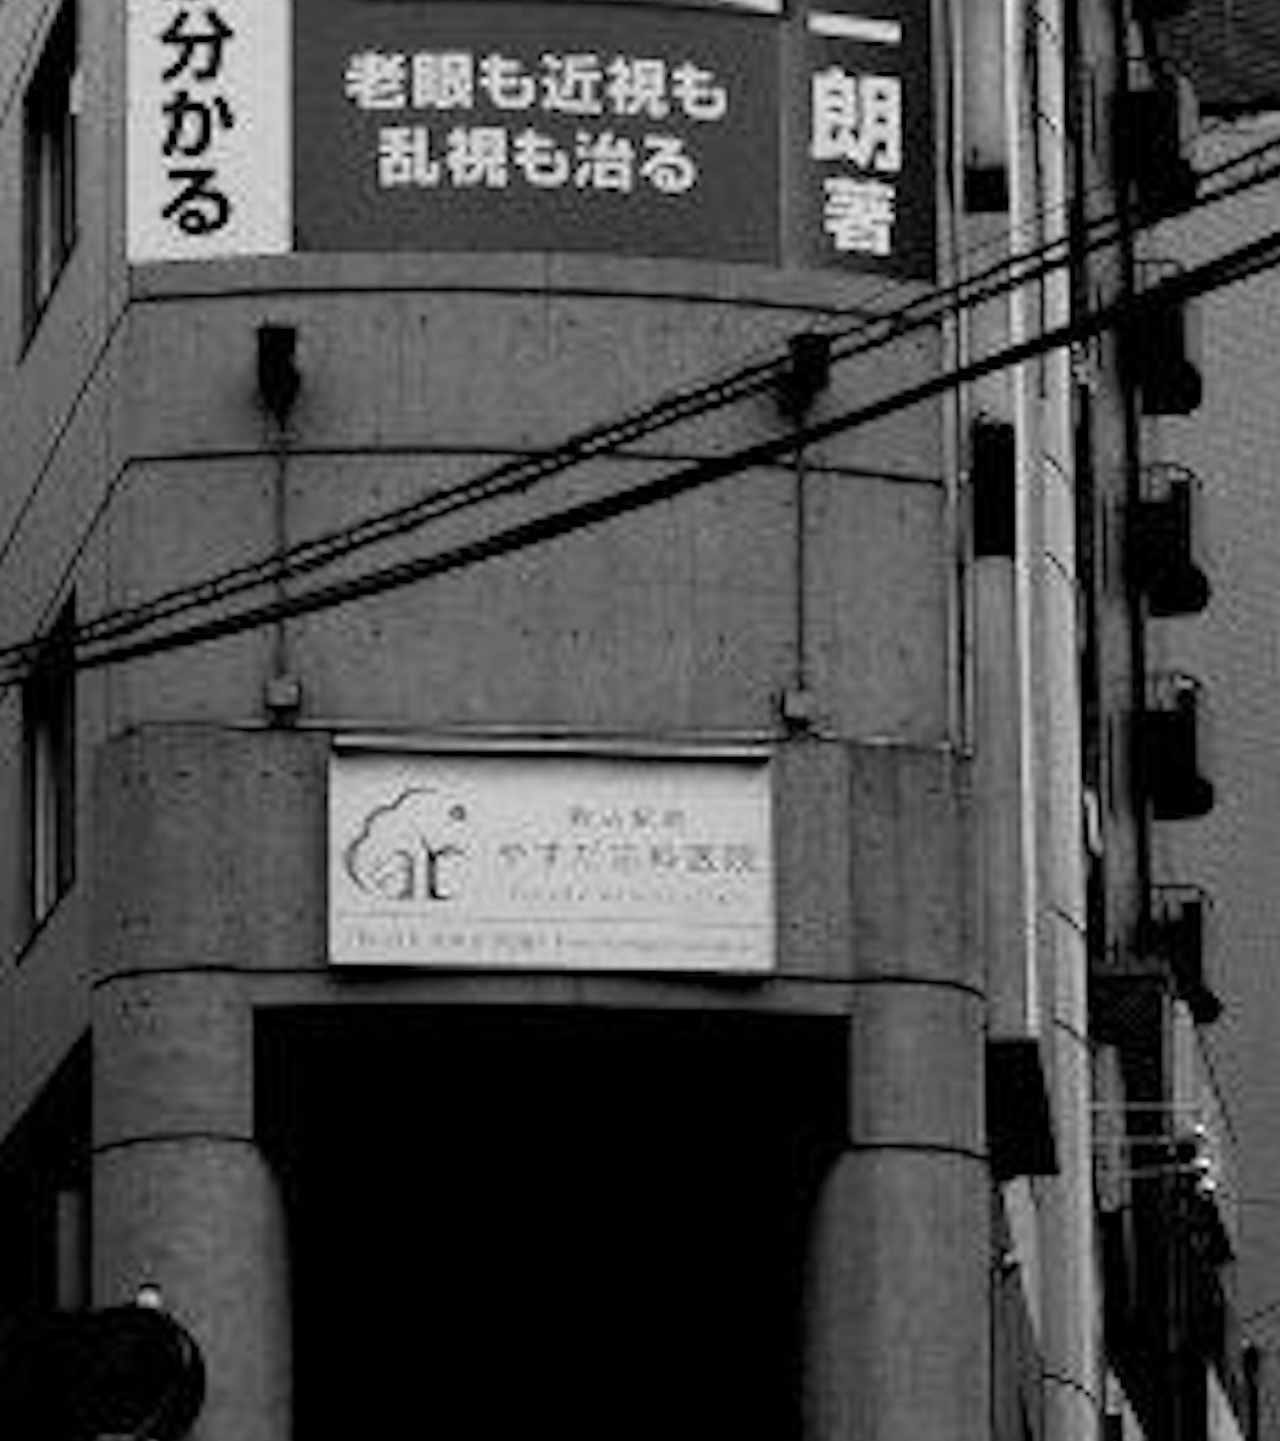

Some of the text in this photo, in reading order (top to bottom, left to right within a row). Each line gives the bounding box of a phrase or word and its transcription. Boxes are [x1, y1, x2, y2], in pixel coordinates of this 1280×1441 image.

[345, 52, 727, 120] 老眼も近視も
[378, 127, 696, 192] 乱視も治る
